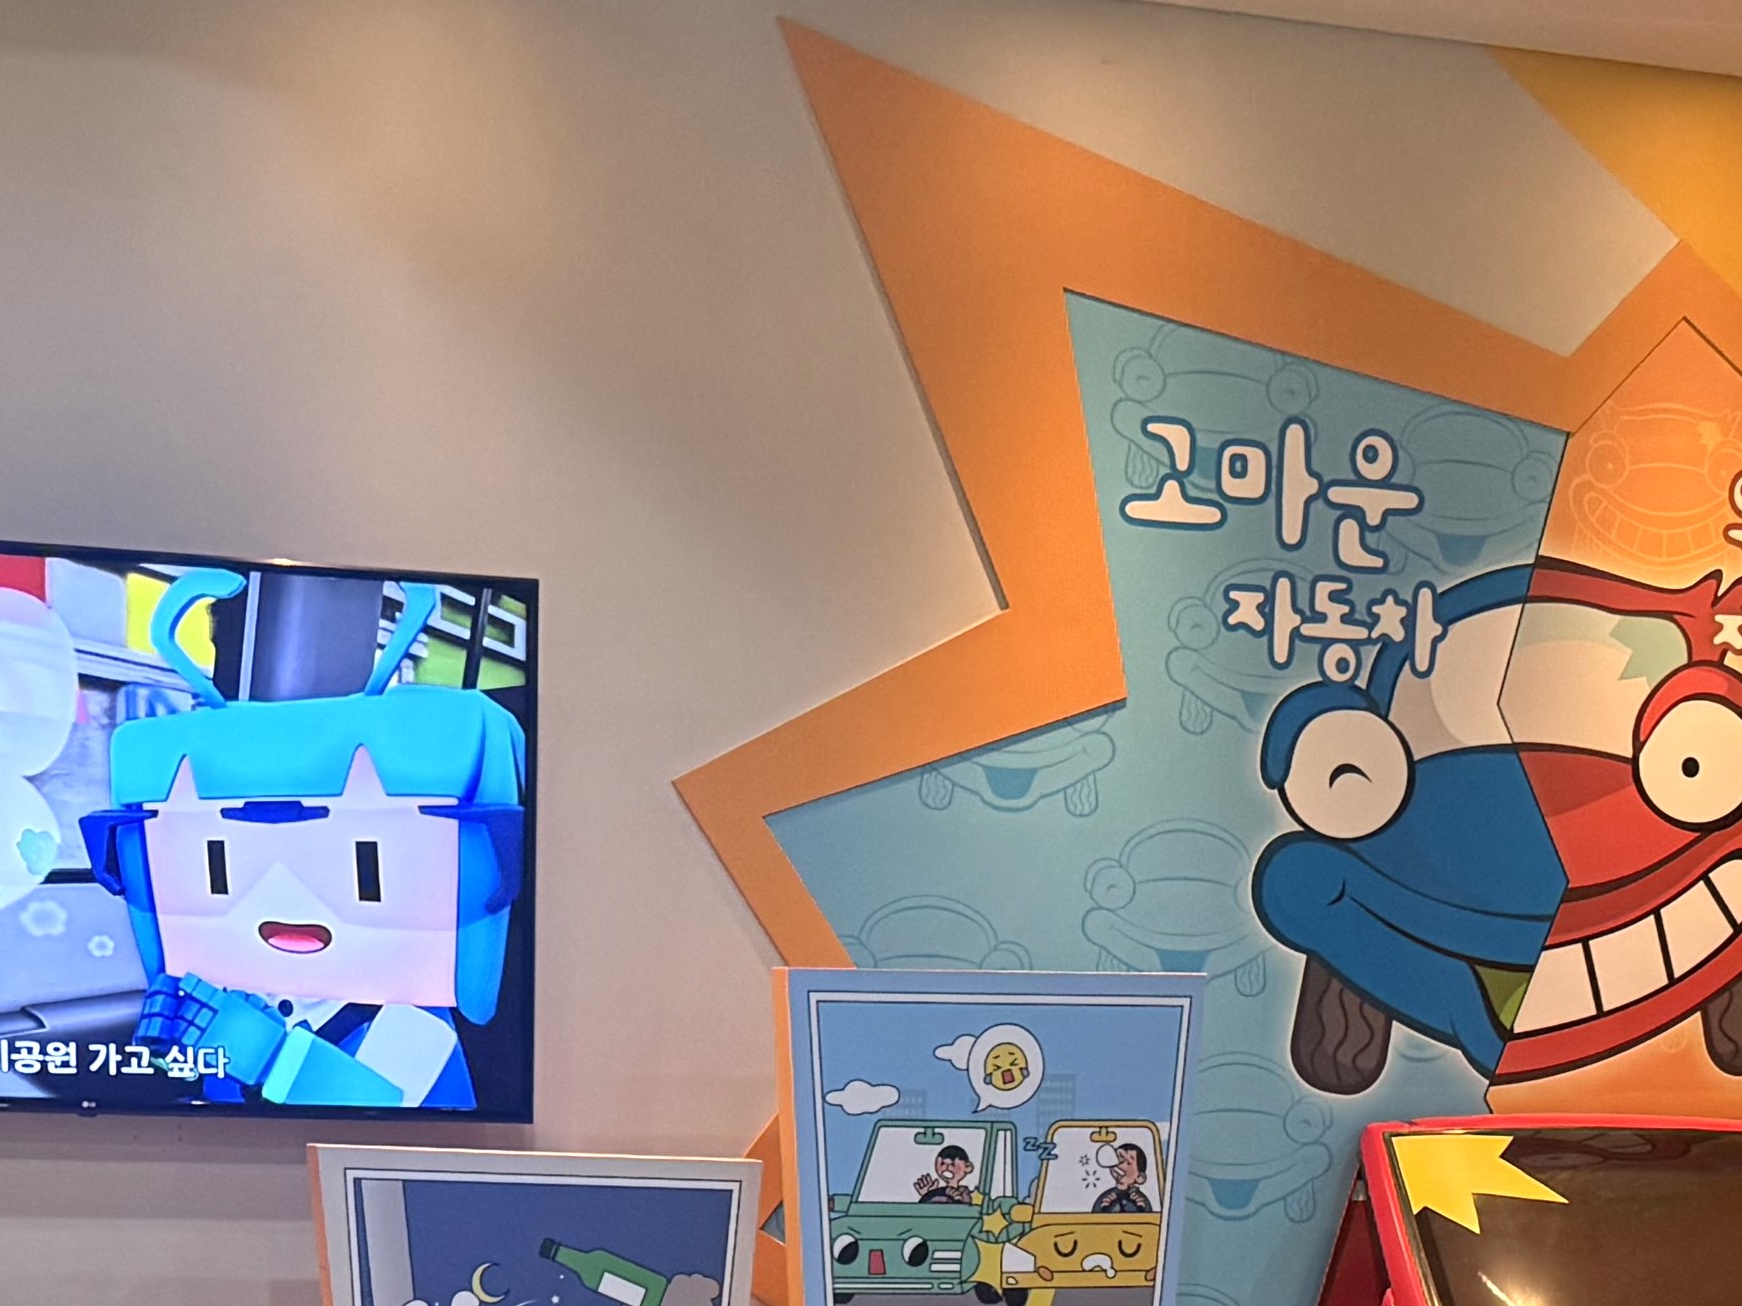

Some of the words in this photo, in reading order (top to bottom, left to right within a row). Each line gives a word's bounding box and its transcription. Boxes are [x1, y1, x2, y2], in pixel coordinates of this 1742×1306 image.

[1120, 414, 1425, 573] 고마운
[1223, 570, 1449, 686] 자동차
[88, 1042, 155, 1077] 가고
[166, 1044, 230, 1079] 싶다
